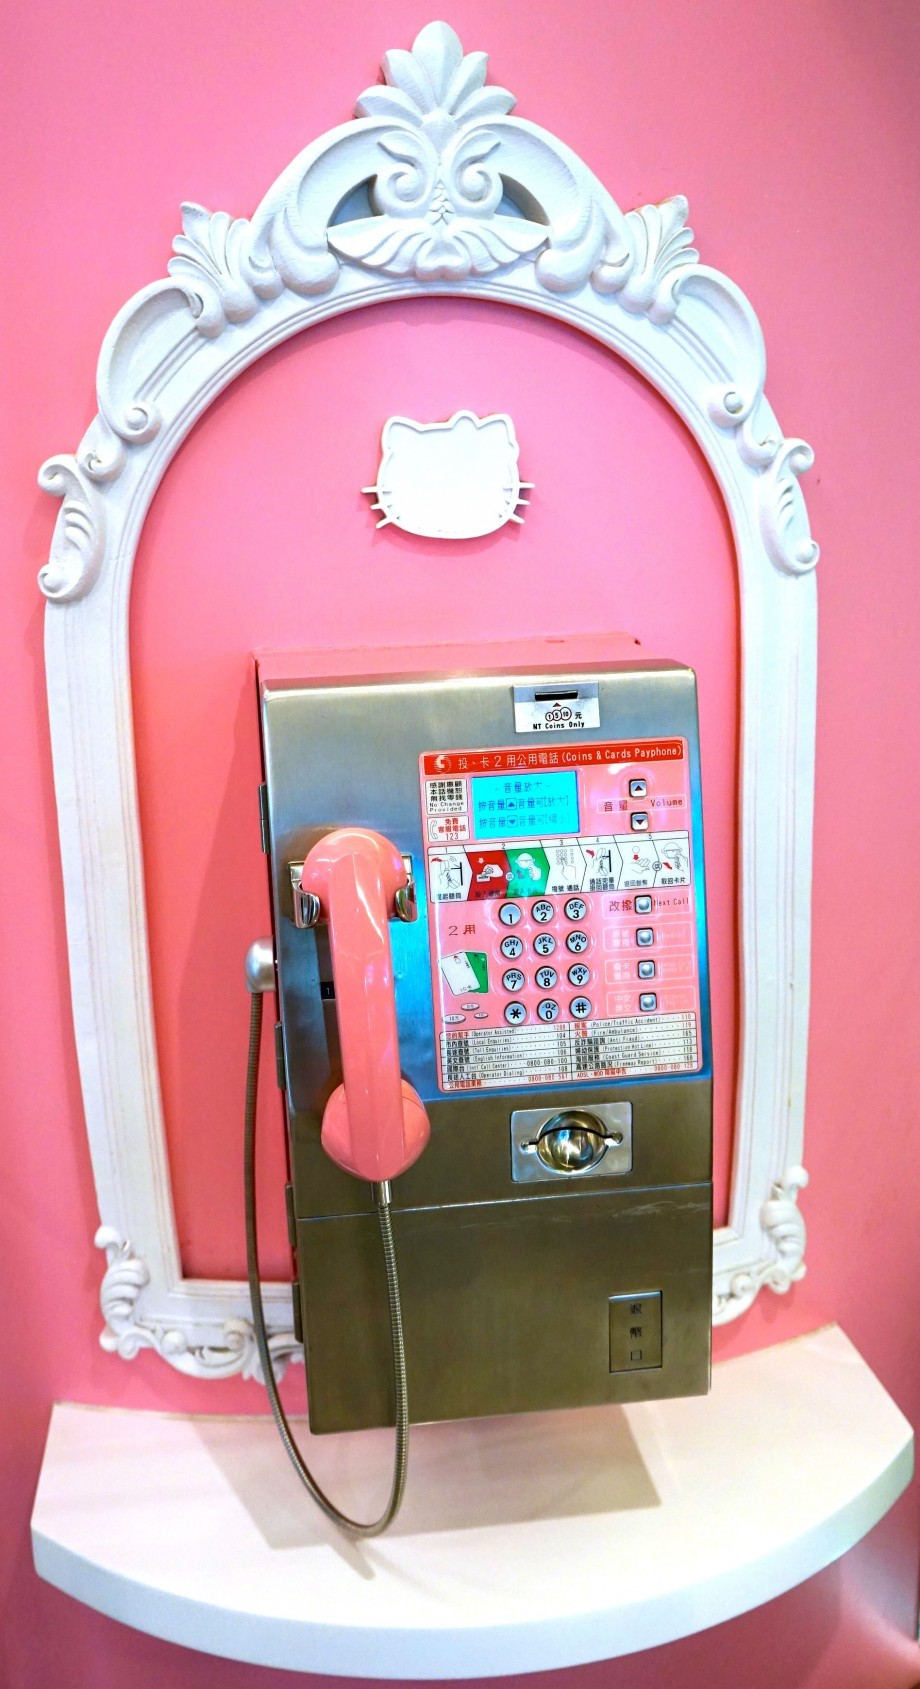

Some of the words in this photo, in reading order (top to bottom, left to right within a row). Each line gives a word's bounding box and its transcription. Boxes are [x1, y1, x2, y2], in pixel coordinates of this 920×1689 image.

[575, 711, 582, 720] 元
[533, 723, 542, 731] NT
[562, 750, 593, 763] (Coins
[596, 750, 602, 760] &
[605, 748, 632, 760] Cards
[634, 744, 682, 759] Payphone)
[651, 799, 683, 807] Volume
[446, 833, 458, 841] 123
[569, 901, 585, 910] DEF
[673, 897, 690, 905] Call
[535, 904, 552, 912] ABC
[540, 911, 547, 921] 2
[572, 909, 580, 919] 3
[538, 936, 553, 945] JKL
[570, 934, 587, 943] MNO
[504, 939, 519, 948] GHI
[574, 941, 582, 952] 6
[509, 947, 516, 956] 4
[542, 944, 550, 954] 5
[540, 970, 555, 978] TUV
[571, 967, 588, 976] WXY
[506, 972, 522, 981] PRS
[576, 975, 584, 984] 9
[511, 979, 518, 989] 7
[543, 978, 551, 987] 8
[545, 1010, 553, 1020] 0
